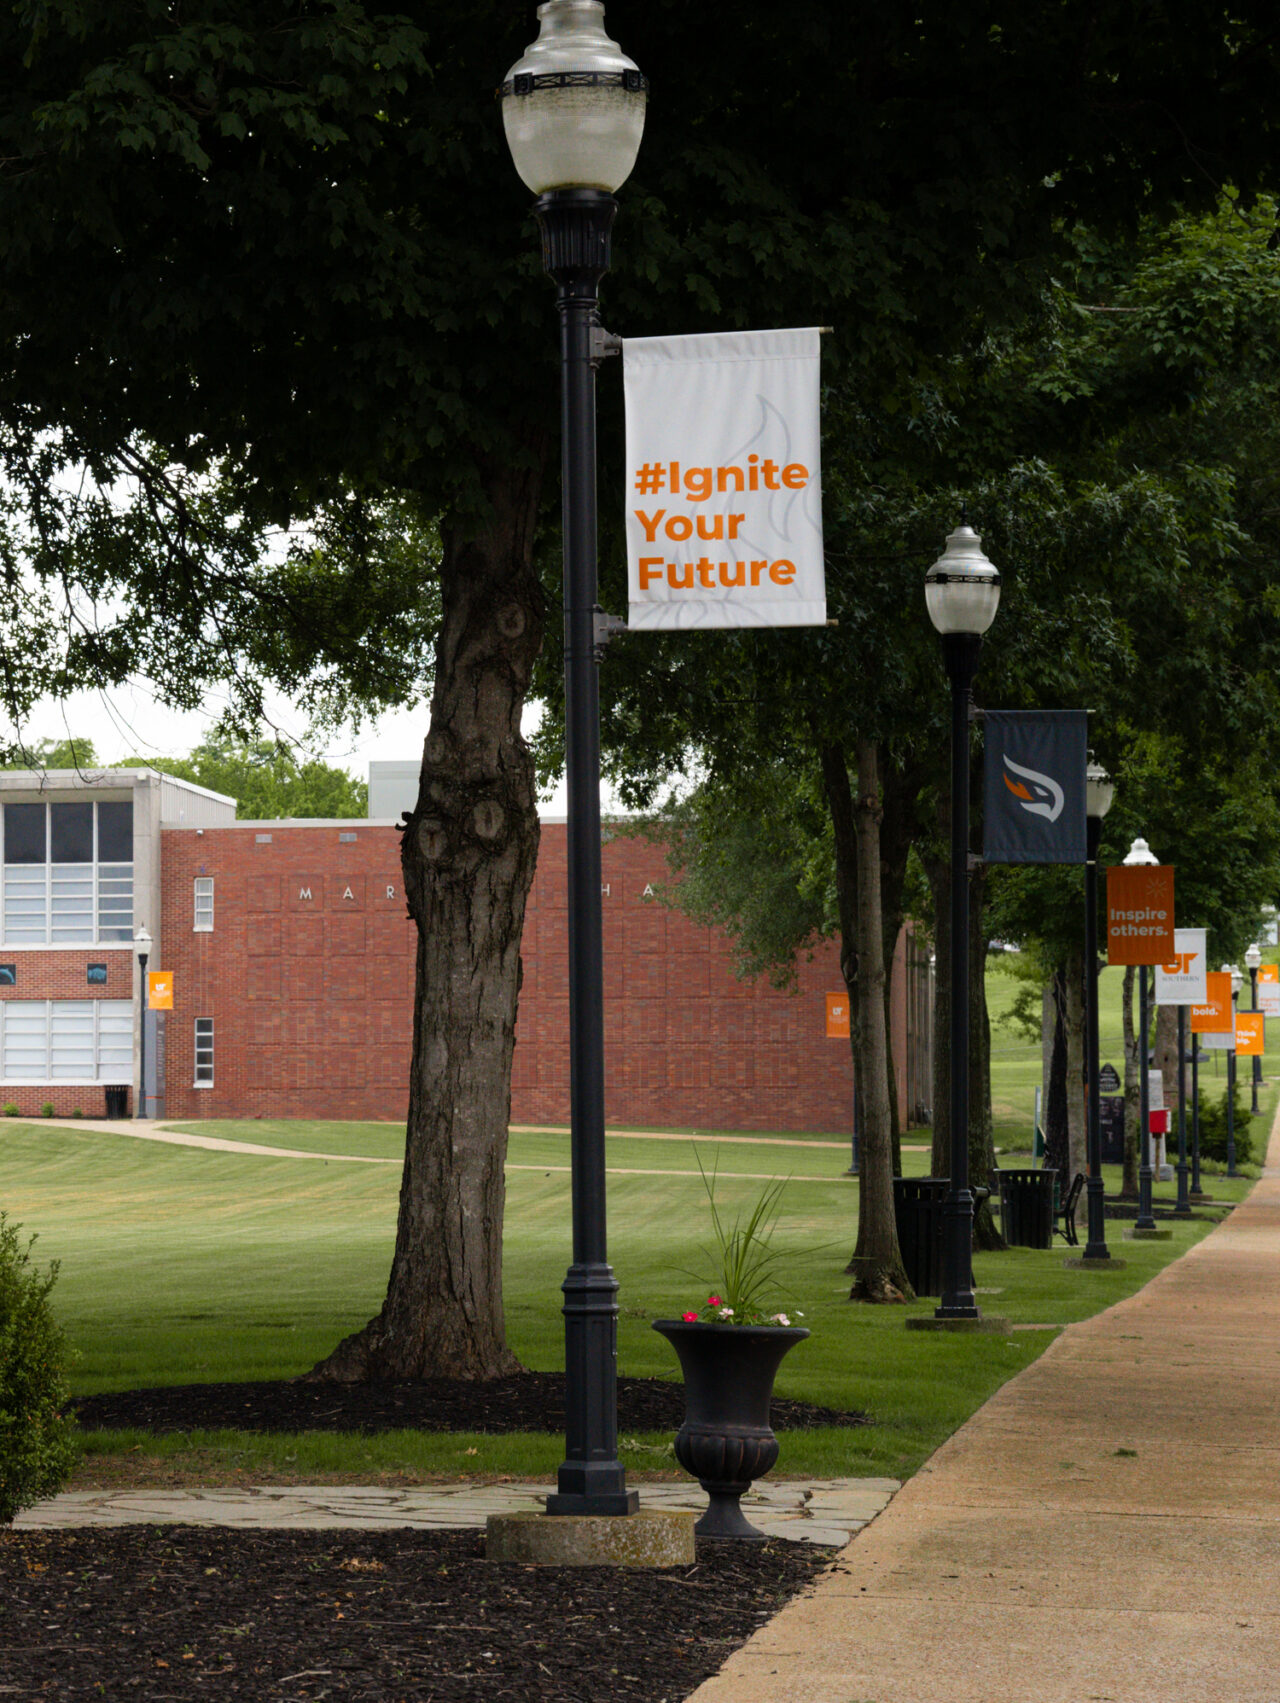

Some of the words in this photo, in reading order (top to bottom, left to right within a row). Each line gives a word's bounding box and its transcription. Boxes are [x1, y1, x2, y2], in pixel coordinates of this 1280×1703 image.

[634, 454, 809, 502] #Ignite
[634, 509, 745, 542] Your
[638, 557, 797, 590] Future
[1110, 906, 1167, 923] Inspire
[1110, 924, 1168, 936] others.
[1192, 1007, 1218, 1015] bold.
